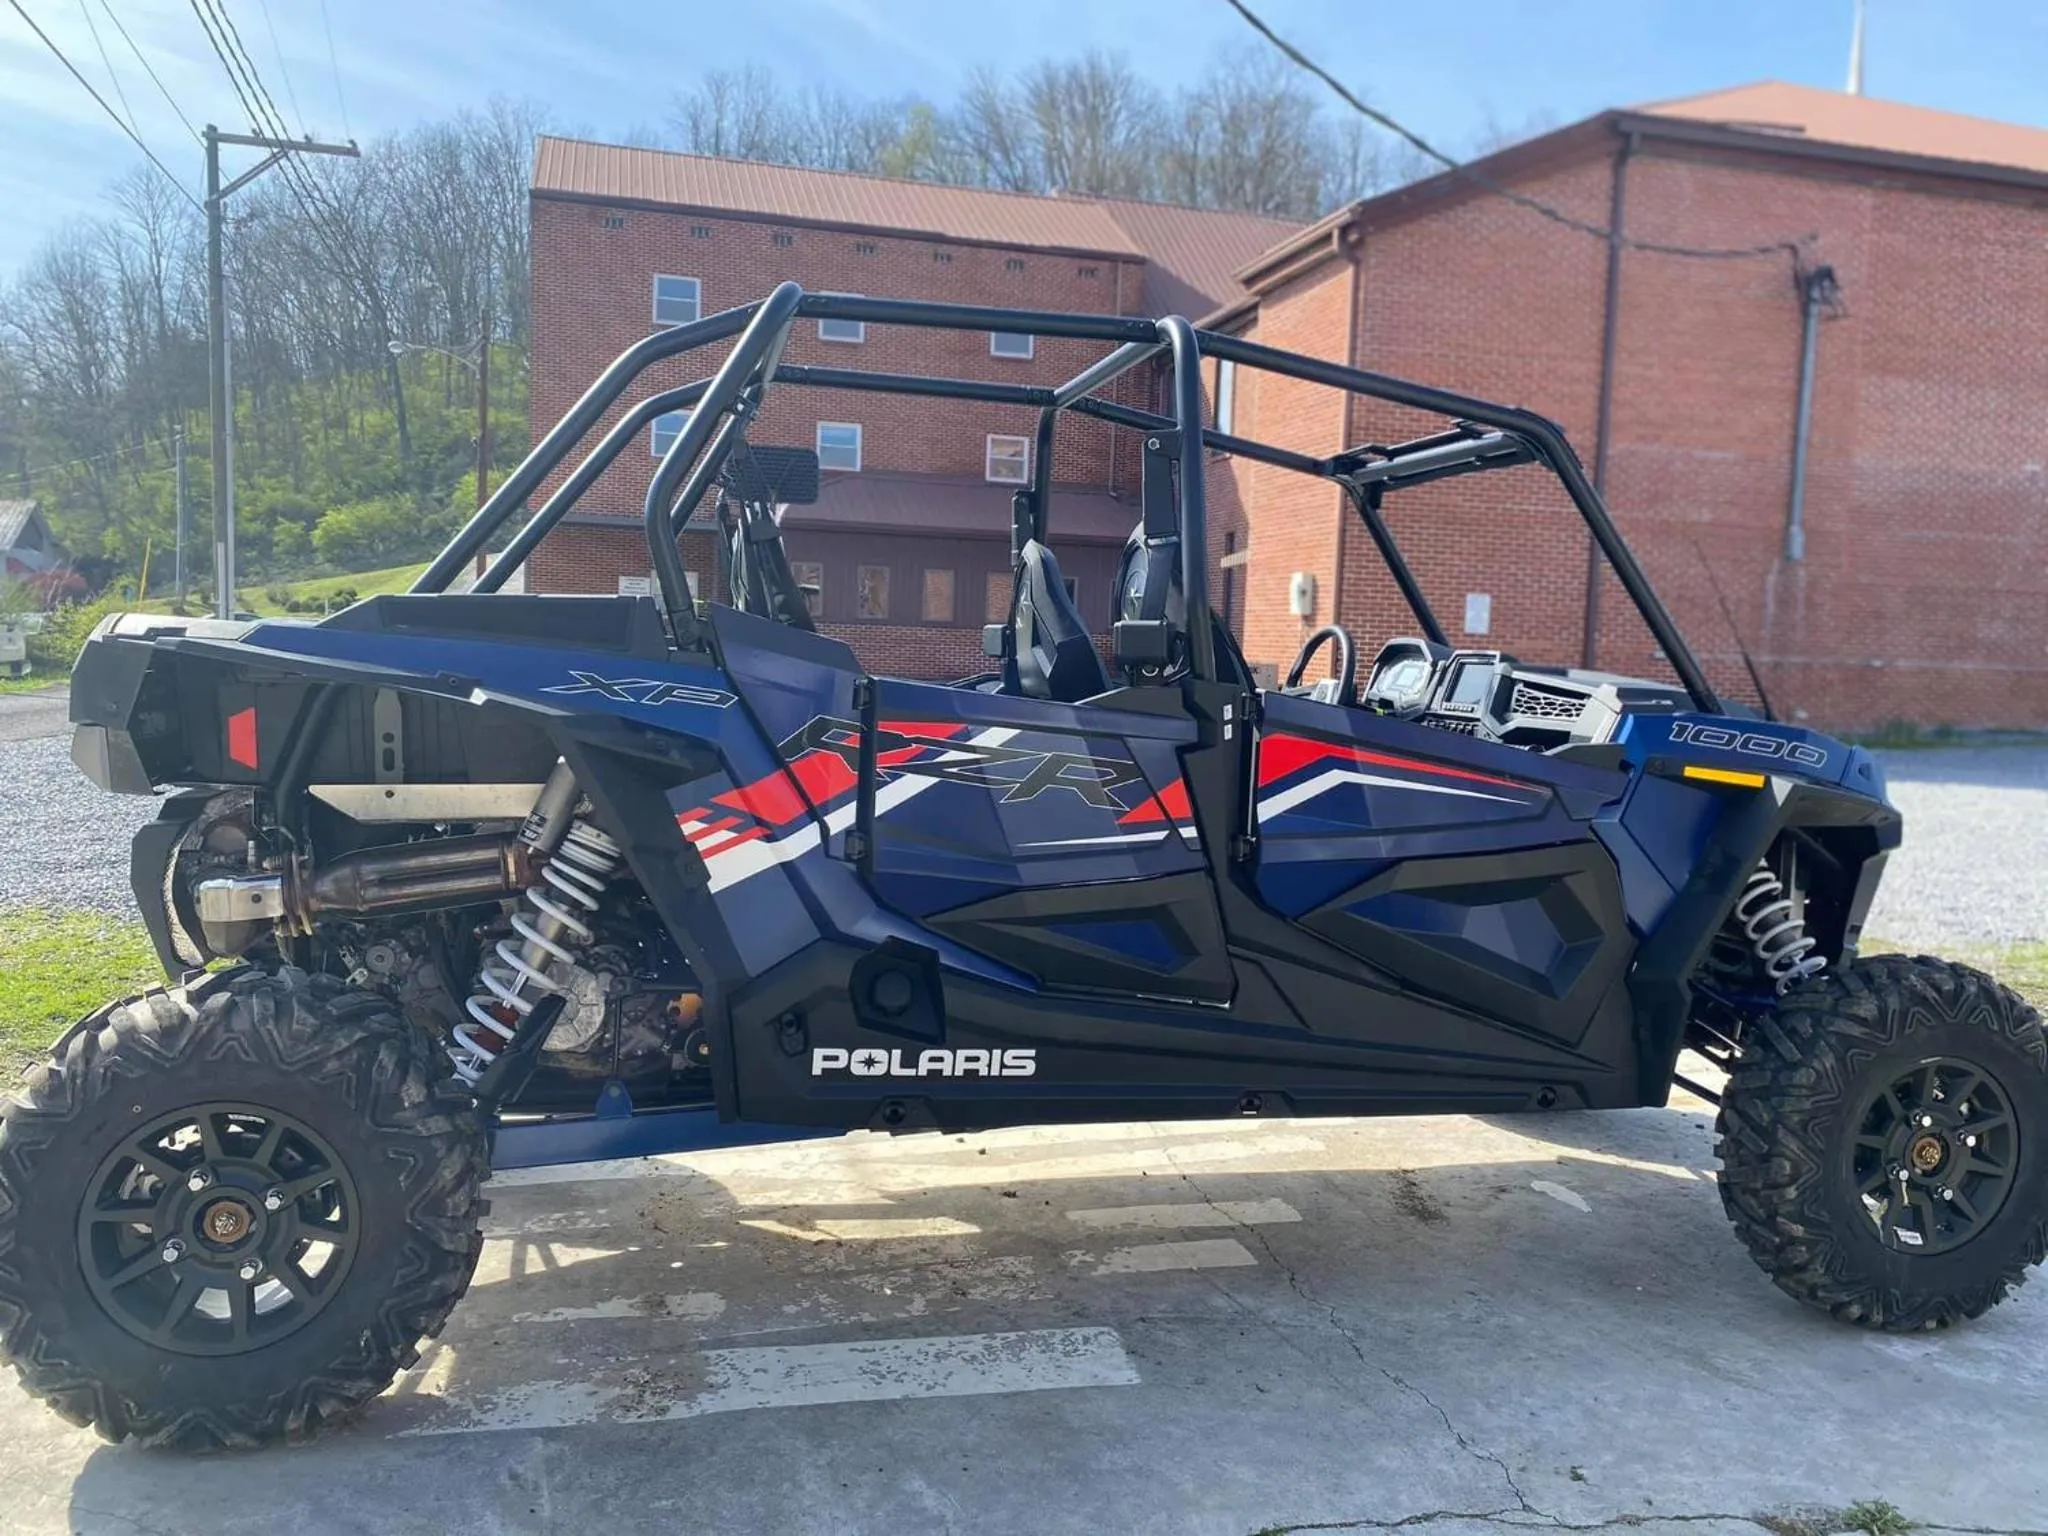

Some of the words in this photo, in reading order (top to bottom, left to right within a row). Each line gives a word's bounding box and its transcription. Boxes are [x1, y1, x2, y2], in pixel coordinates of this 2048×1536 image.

[538, 670, 739, 709] XP
[776, 715, 1143, 812] RZR
[1669, 721, 1828, 768] 1000
[811, 1047, 1037, 1077] POLARIS
